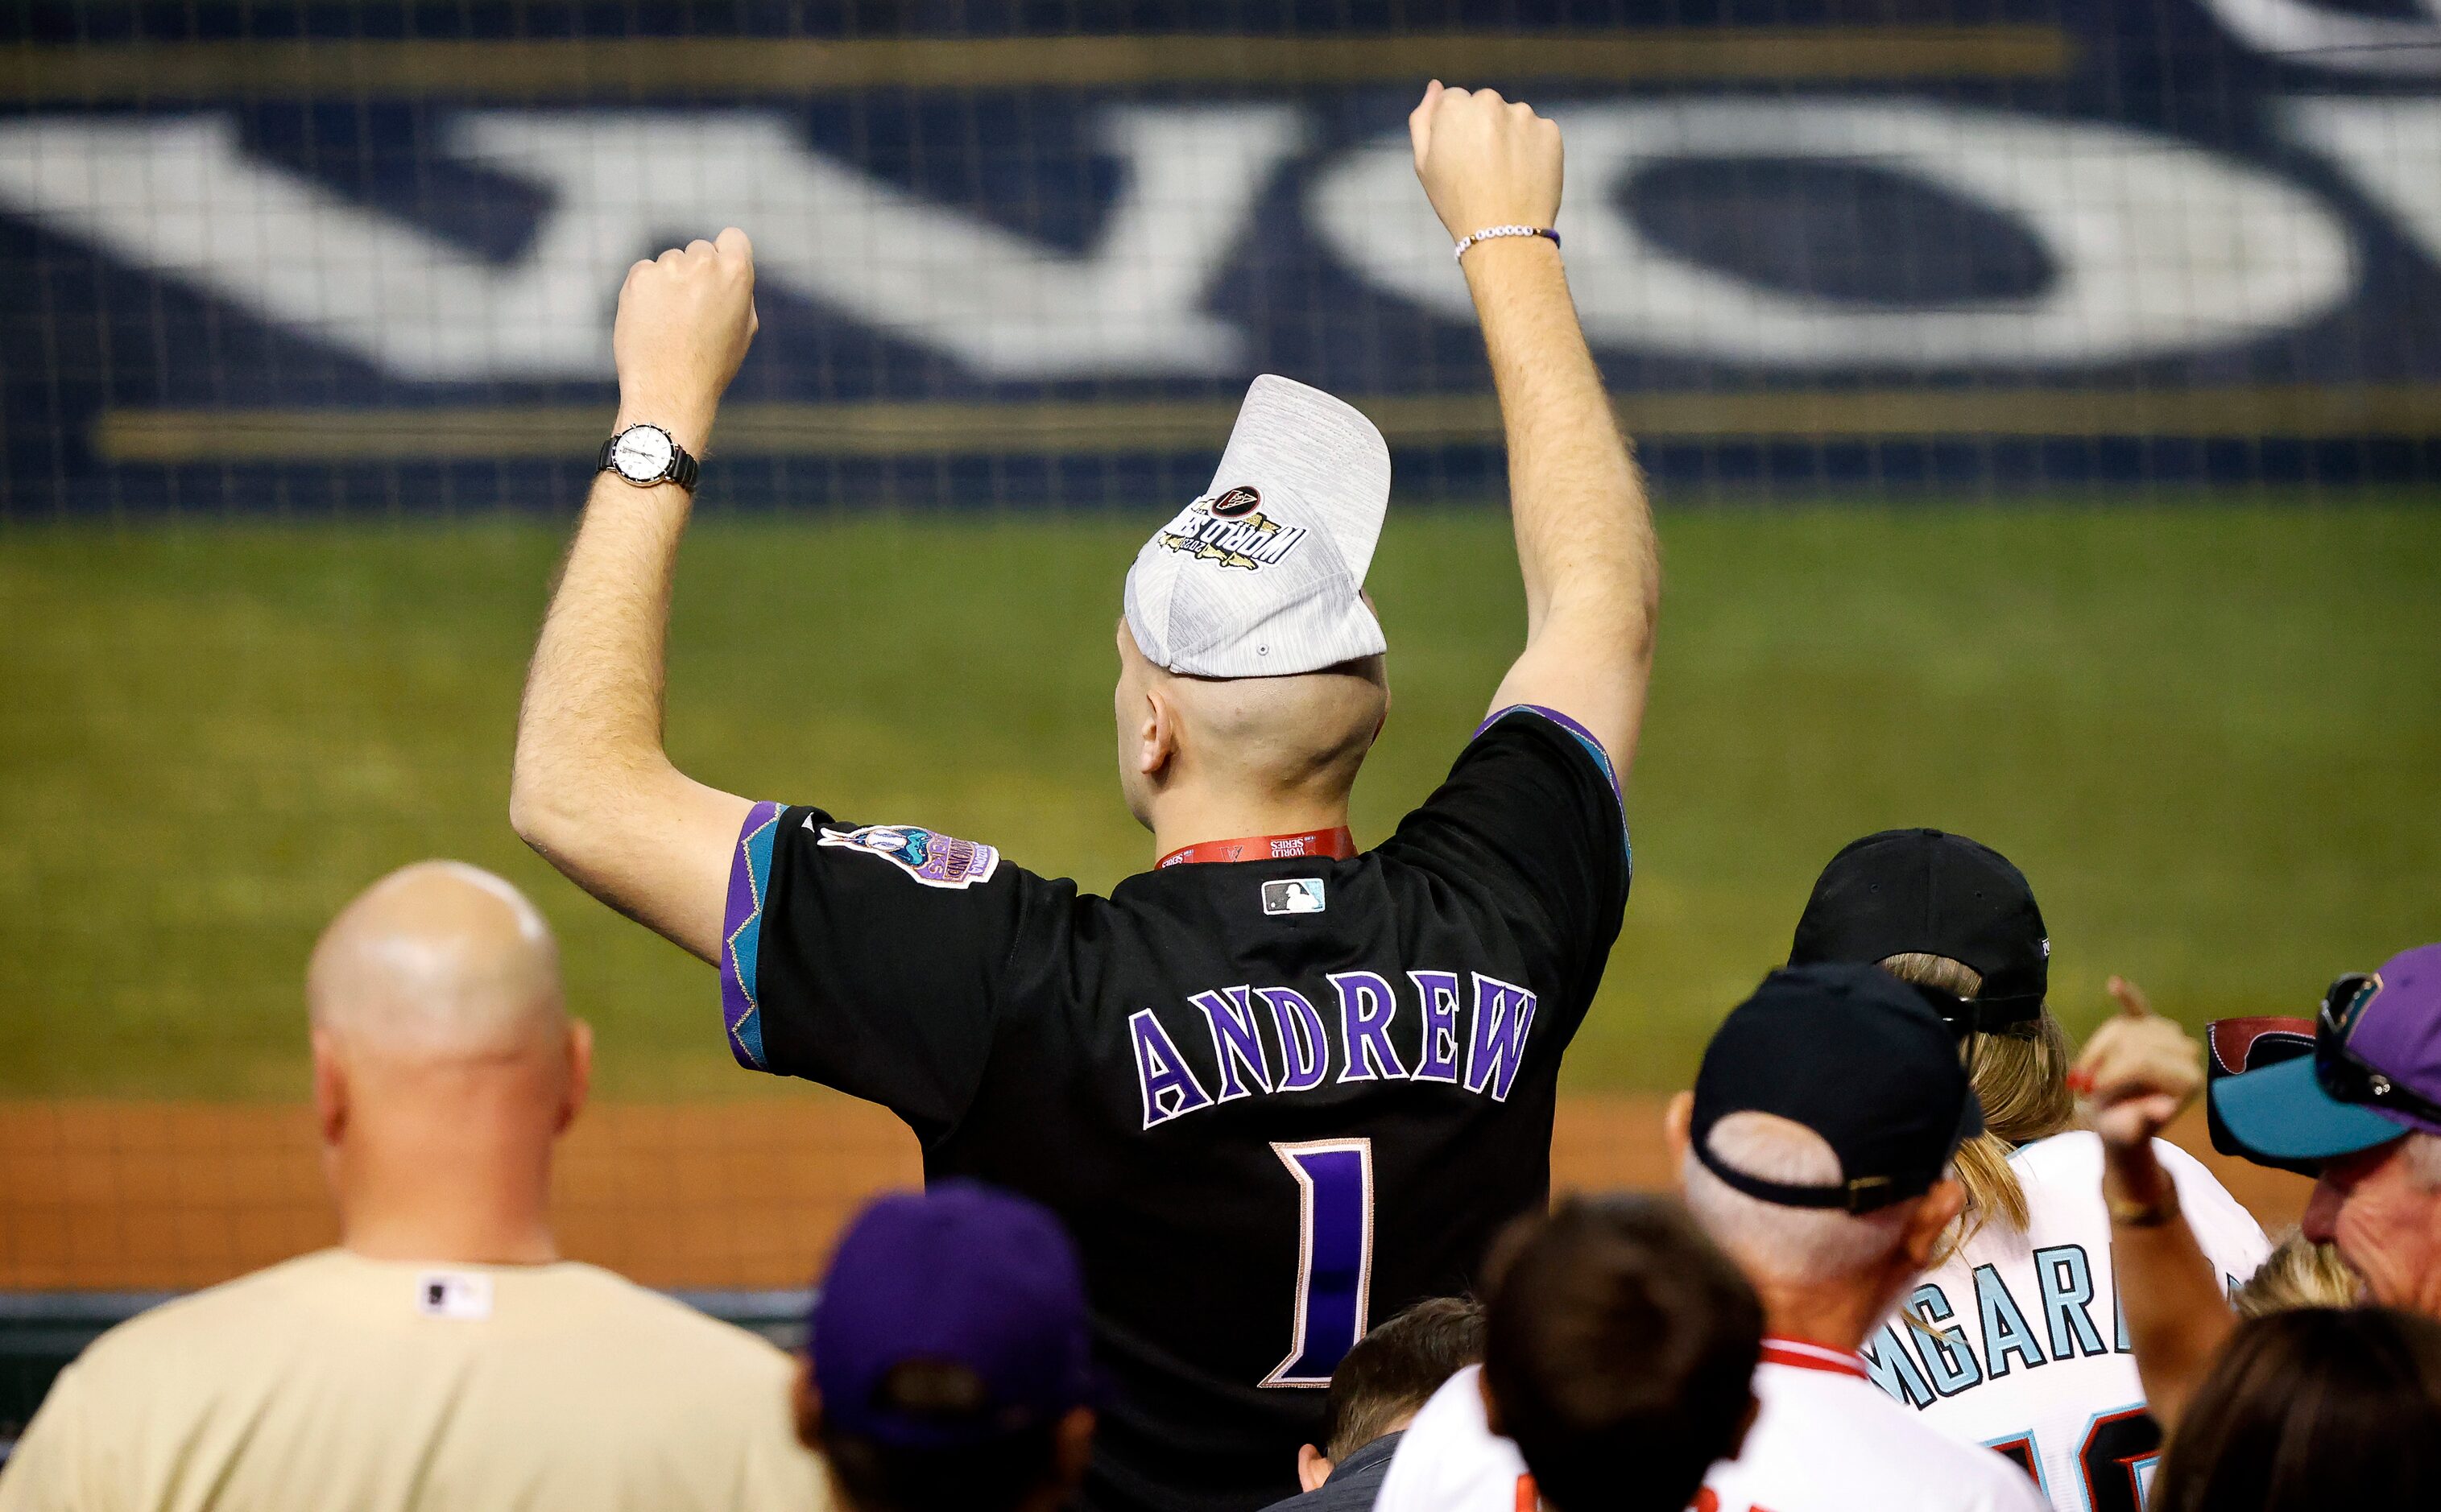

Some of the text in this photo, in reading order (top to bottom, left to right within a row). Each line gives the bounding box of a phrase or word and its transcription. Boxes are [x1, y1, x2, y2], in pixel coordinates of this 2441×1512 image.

[1200, 519, 1306, 564] WORLD
[1270, 838, 1304, 850] SERIES
[1272, 847, 1305, 858] WORLD
[1128, 970, 1537, 1130] ANDREW
[1257, 1137, 1375, 1388] 1
[1858, 1244, 2134, 1411] MGAR
